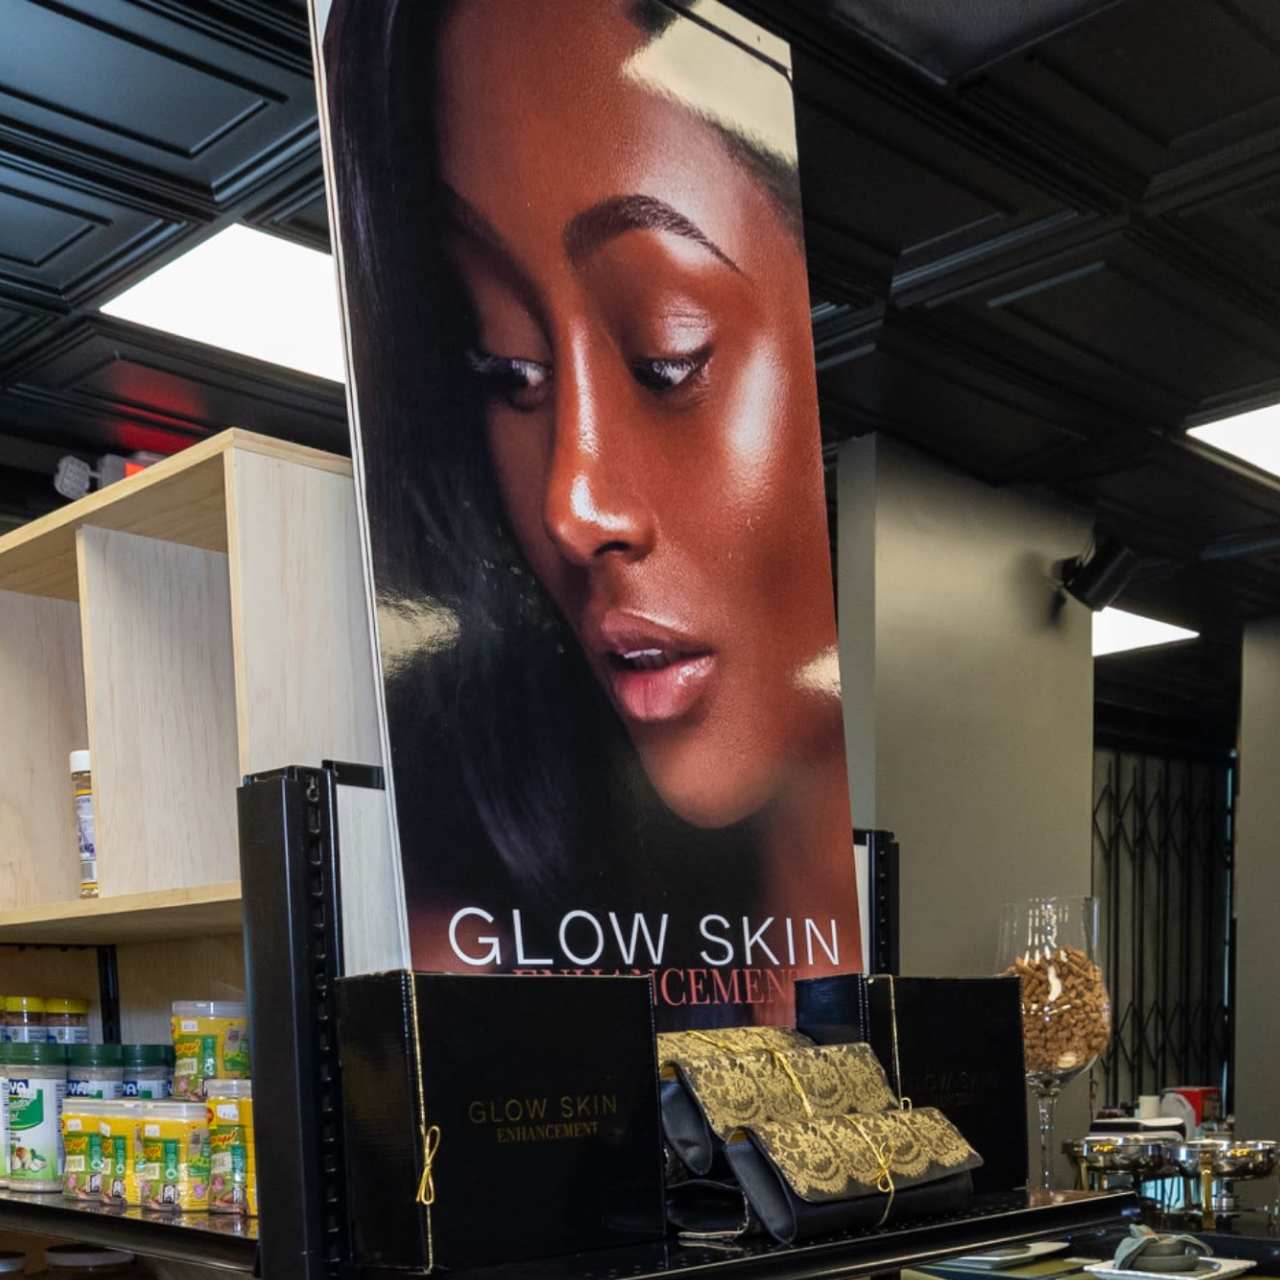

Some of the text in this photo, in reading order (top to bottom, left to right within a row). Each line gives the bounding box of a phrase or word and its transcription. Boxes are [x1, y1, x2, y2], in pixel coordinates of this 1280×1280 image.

[448, 906, 841, 967] GLOW SKIN
[470, 1094, 618, 1124] GLOW SKIN
[496, 1121, 600, 1143] ENHANCEMENT
